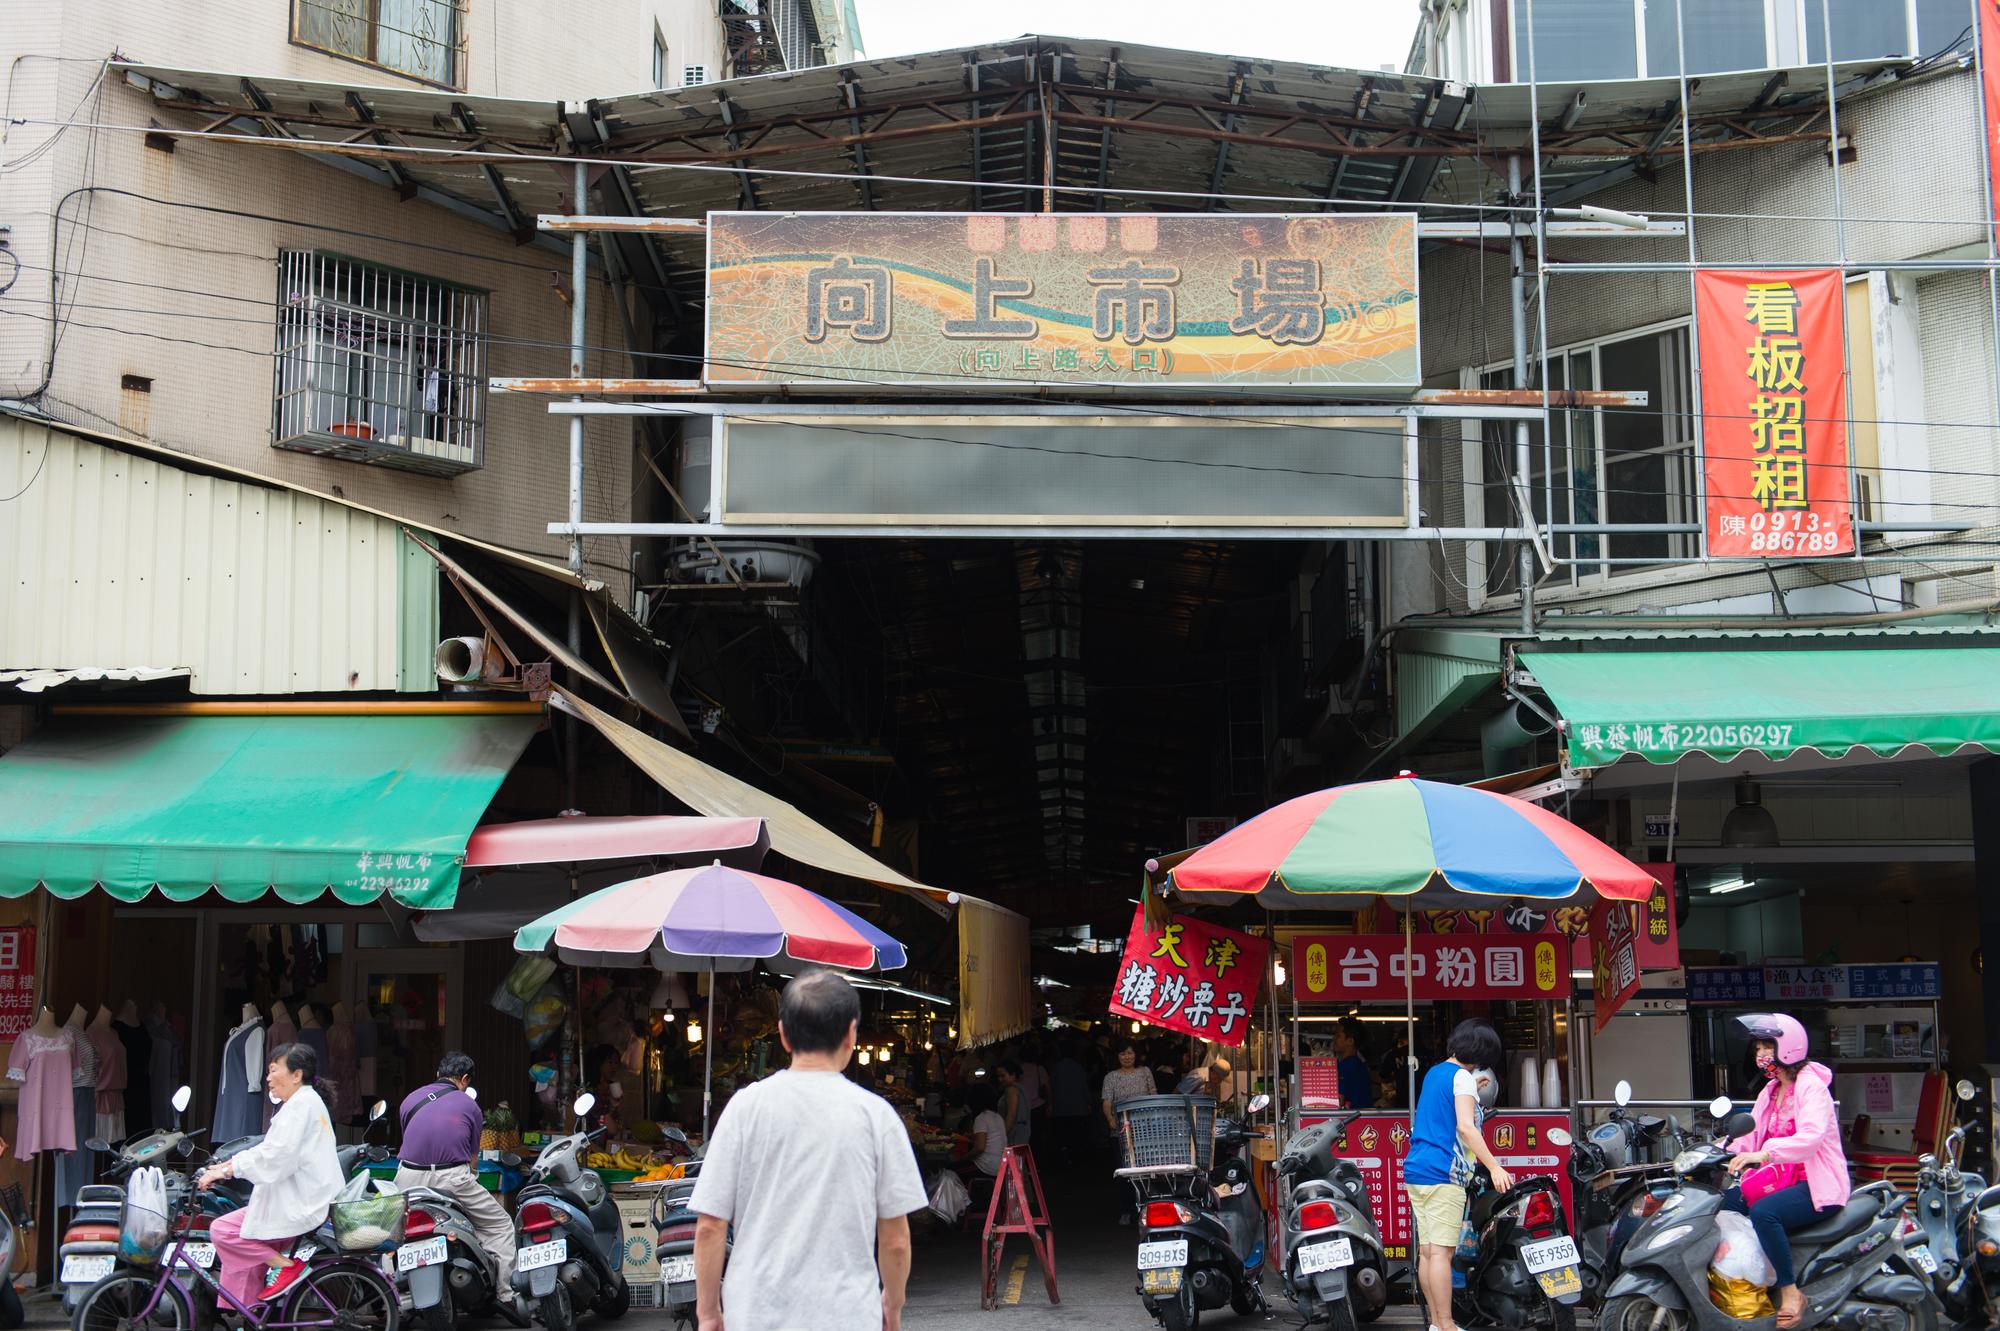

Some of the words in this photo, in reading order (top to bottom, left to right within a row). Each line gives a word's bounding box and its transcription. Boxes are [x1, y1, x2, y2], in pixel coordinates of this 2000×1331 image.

[803, 256, 1328, 345] 向上市場
[958, 347, 1176, 375] (向上路入口)
[1743, 281, 1809, 511] 看板招租
[1719, 515, 1747, 537] 陳
[1750, 512, 1832, 532] 0913-
[1750, 531, 1839, 551] 886789
[1648, 823, 1678, 836] 21
[1648, 895, 1668, 937] 傳統
[1150, 923, 1241, 979] 天津
[1308, 950, 1326, 987] 傳統
[1338, 946, 1526, 988] 台中粉圓
[1537, 949, 1555, 985] 傳統
[1118, 960, 1247, 1036] 糖炒栗子
[1139, 1247, 1187, 1265] 909-BXS
